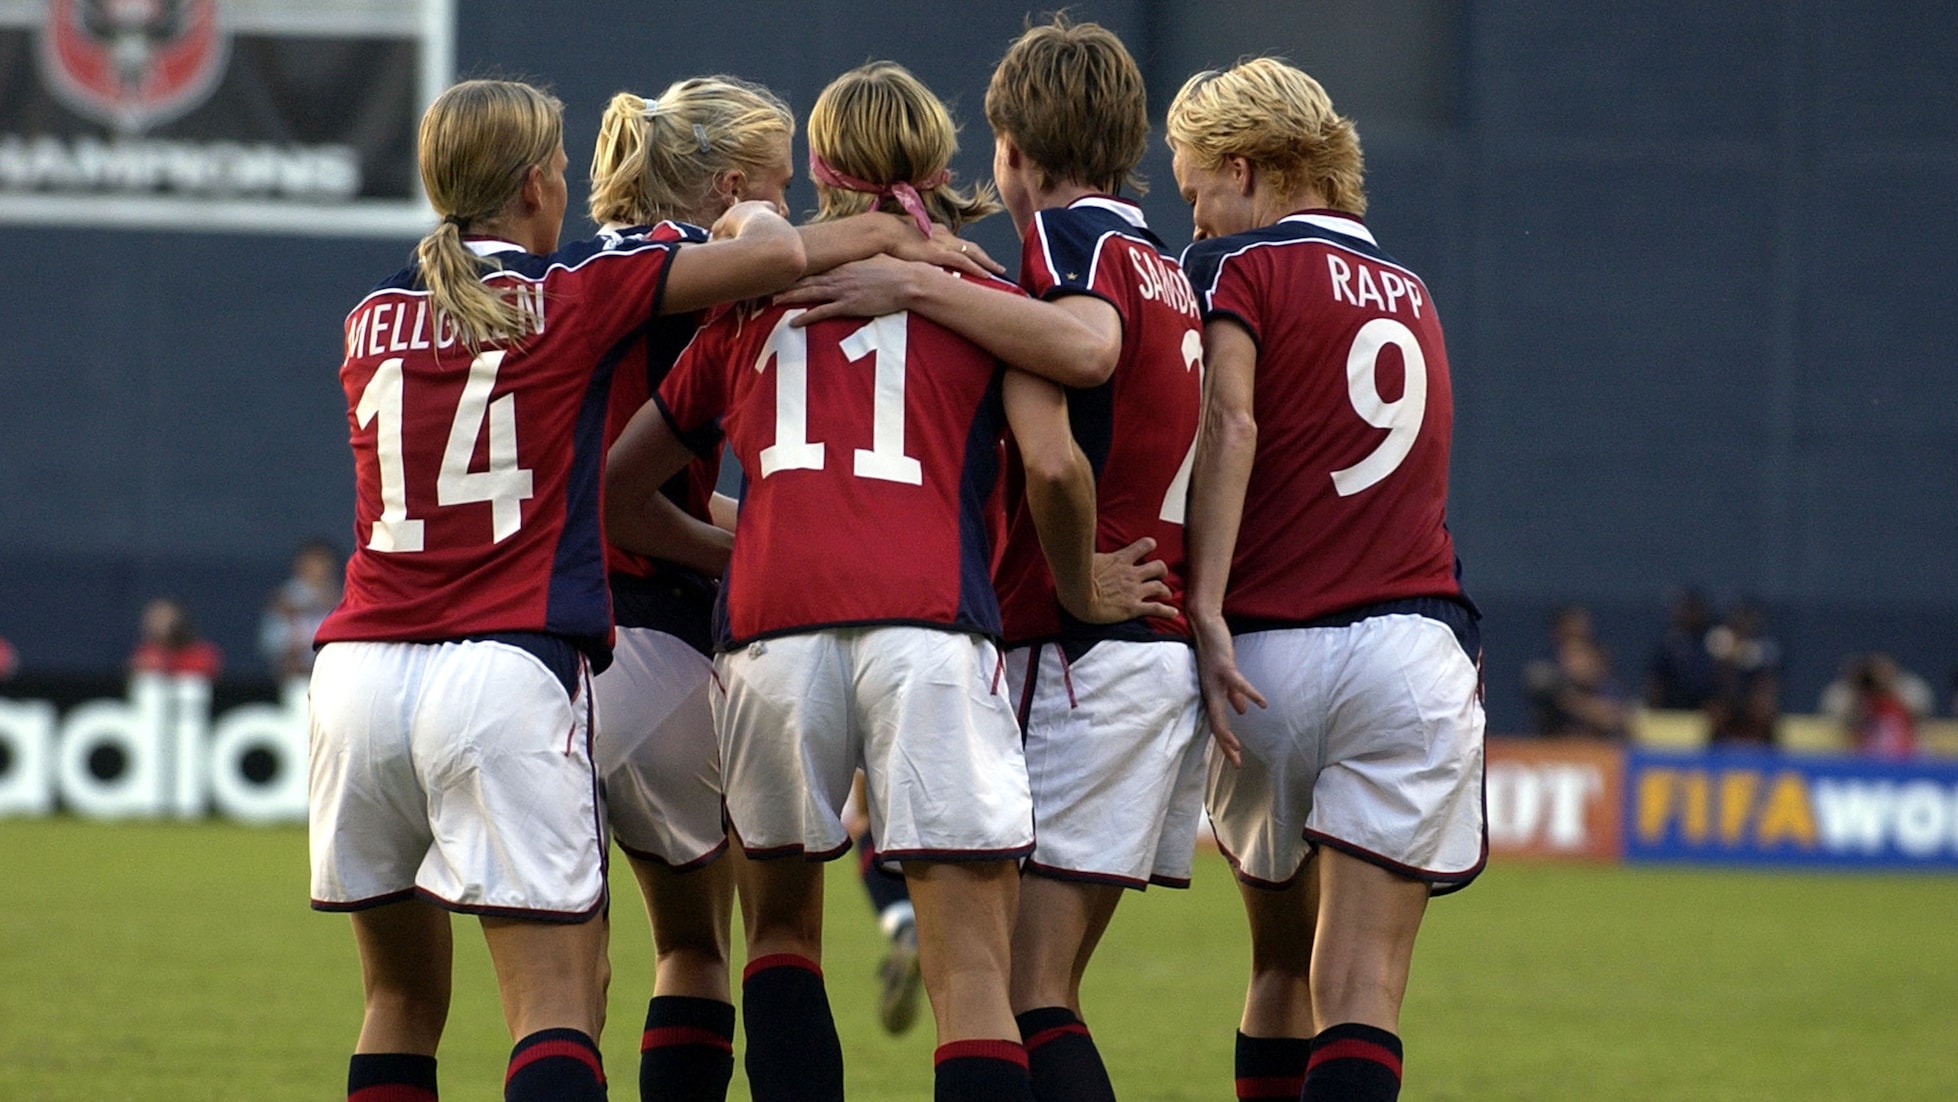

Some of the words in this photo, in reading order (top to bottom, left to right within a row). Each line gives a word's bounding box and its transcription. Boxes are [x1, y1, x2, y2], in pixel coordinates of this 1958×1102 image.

[344, 283, 545, 367] MELLGN
[1326, 253, 1423, 319] RAPP
[355, 350, 533, 553] 14
[754, 308, 923, 486] 11
[1330, 318, 1427, 497] 9
[1637, 768, 1818, 846] FIFA
[1816, 777, 1958, 855] WO
